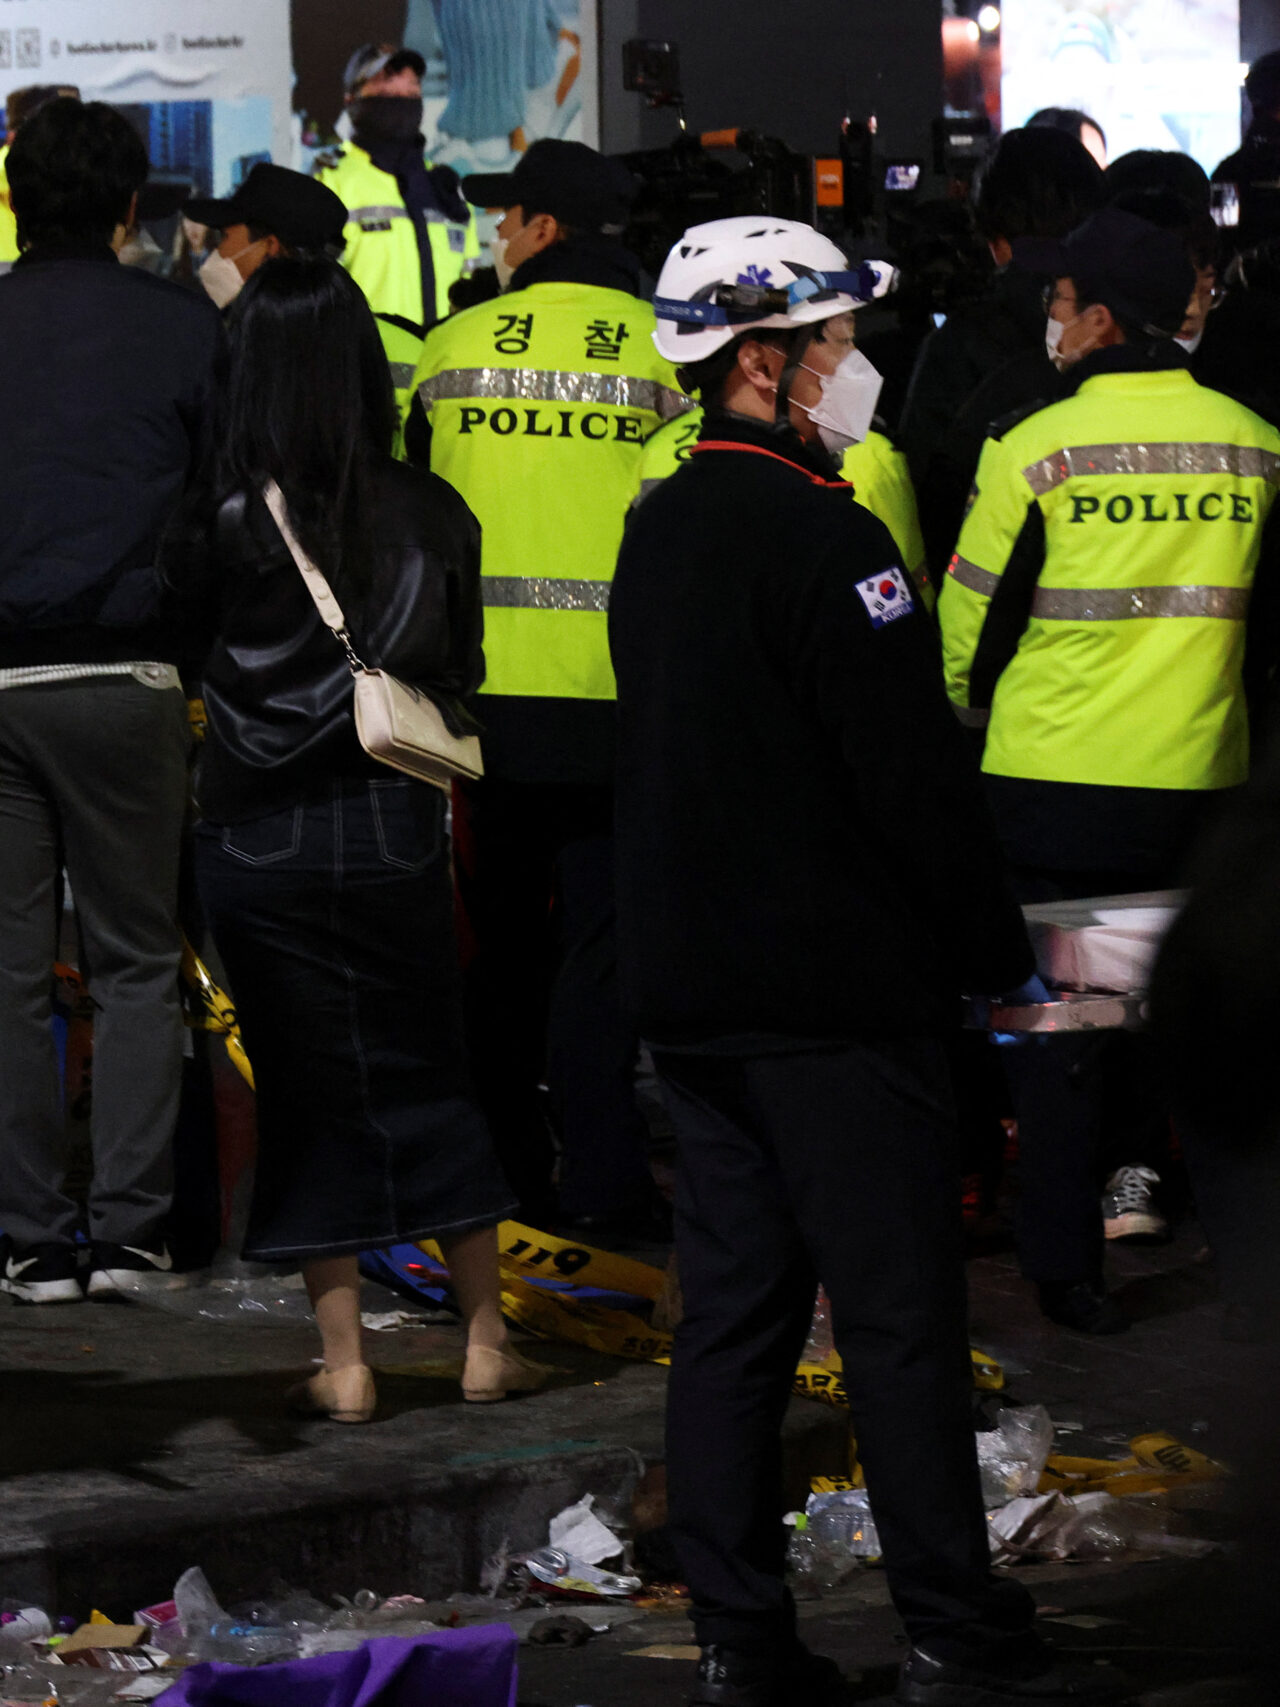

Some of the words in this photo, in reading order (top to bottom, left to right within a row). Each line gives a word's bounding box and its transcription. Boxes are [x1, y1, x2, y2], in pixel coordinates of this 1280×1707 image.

[458, 406, 645, 445] POLICE
[1069, 492, 1255, 524] POLICE
[505, 1238, 592, 1276] 119
